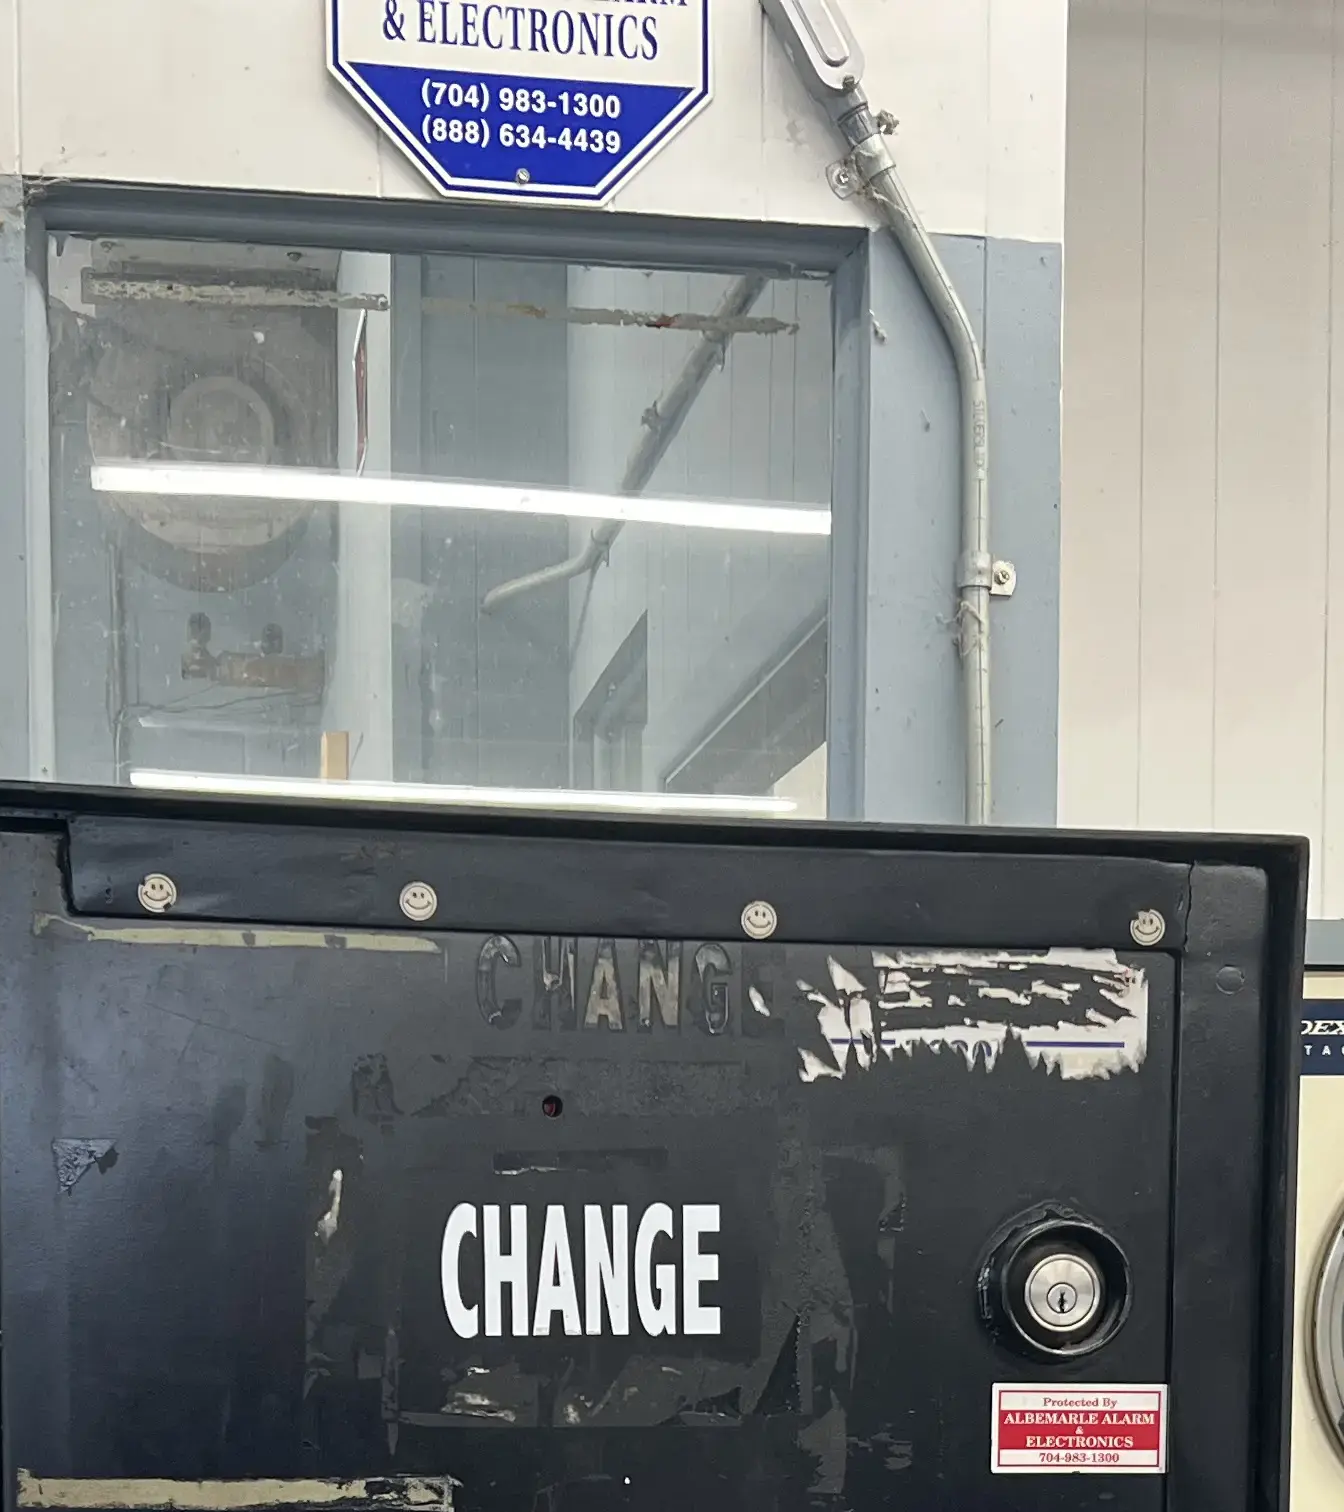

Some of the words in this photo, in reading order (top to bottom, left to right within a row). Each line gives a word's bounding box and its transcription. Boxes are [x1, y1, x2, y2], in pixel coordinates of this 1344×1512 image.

[382, 0, 406, 42] &
[417, 0, 659, 61] ELECTRONICS
[421, 78, 490, 113] (704)
[499, 87, 621, 119] 983-1300
[421, 114, 490, 148] (888)
[499, 123, 621, 154] 634-4439
[441, 1202, 722, 1340] CHANGE
[1043, 1397, 1099, 1407] Protected
[1102, 1397, 1117, 1409] By
[1004, 1412, 1099, 1425] ALBEMARLE
[1101, 1413, 1155, 1425] ALARM
[1075, 1426, 1084, 1435] &
[1025, 1435, 1134, 1448] ELECTRONICS
[1039, 1452, 1120, 1463] 704-983-1300
